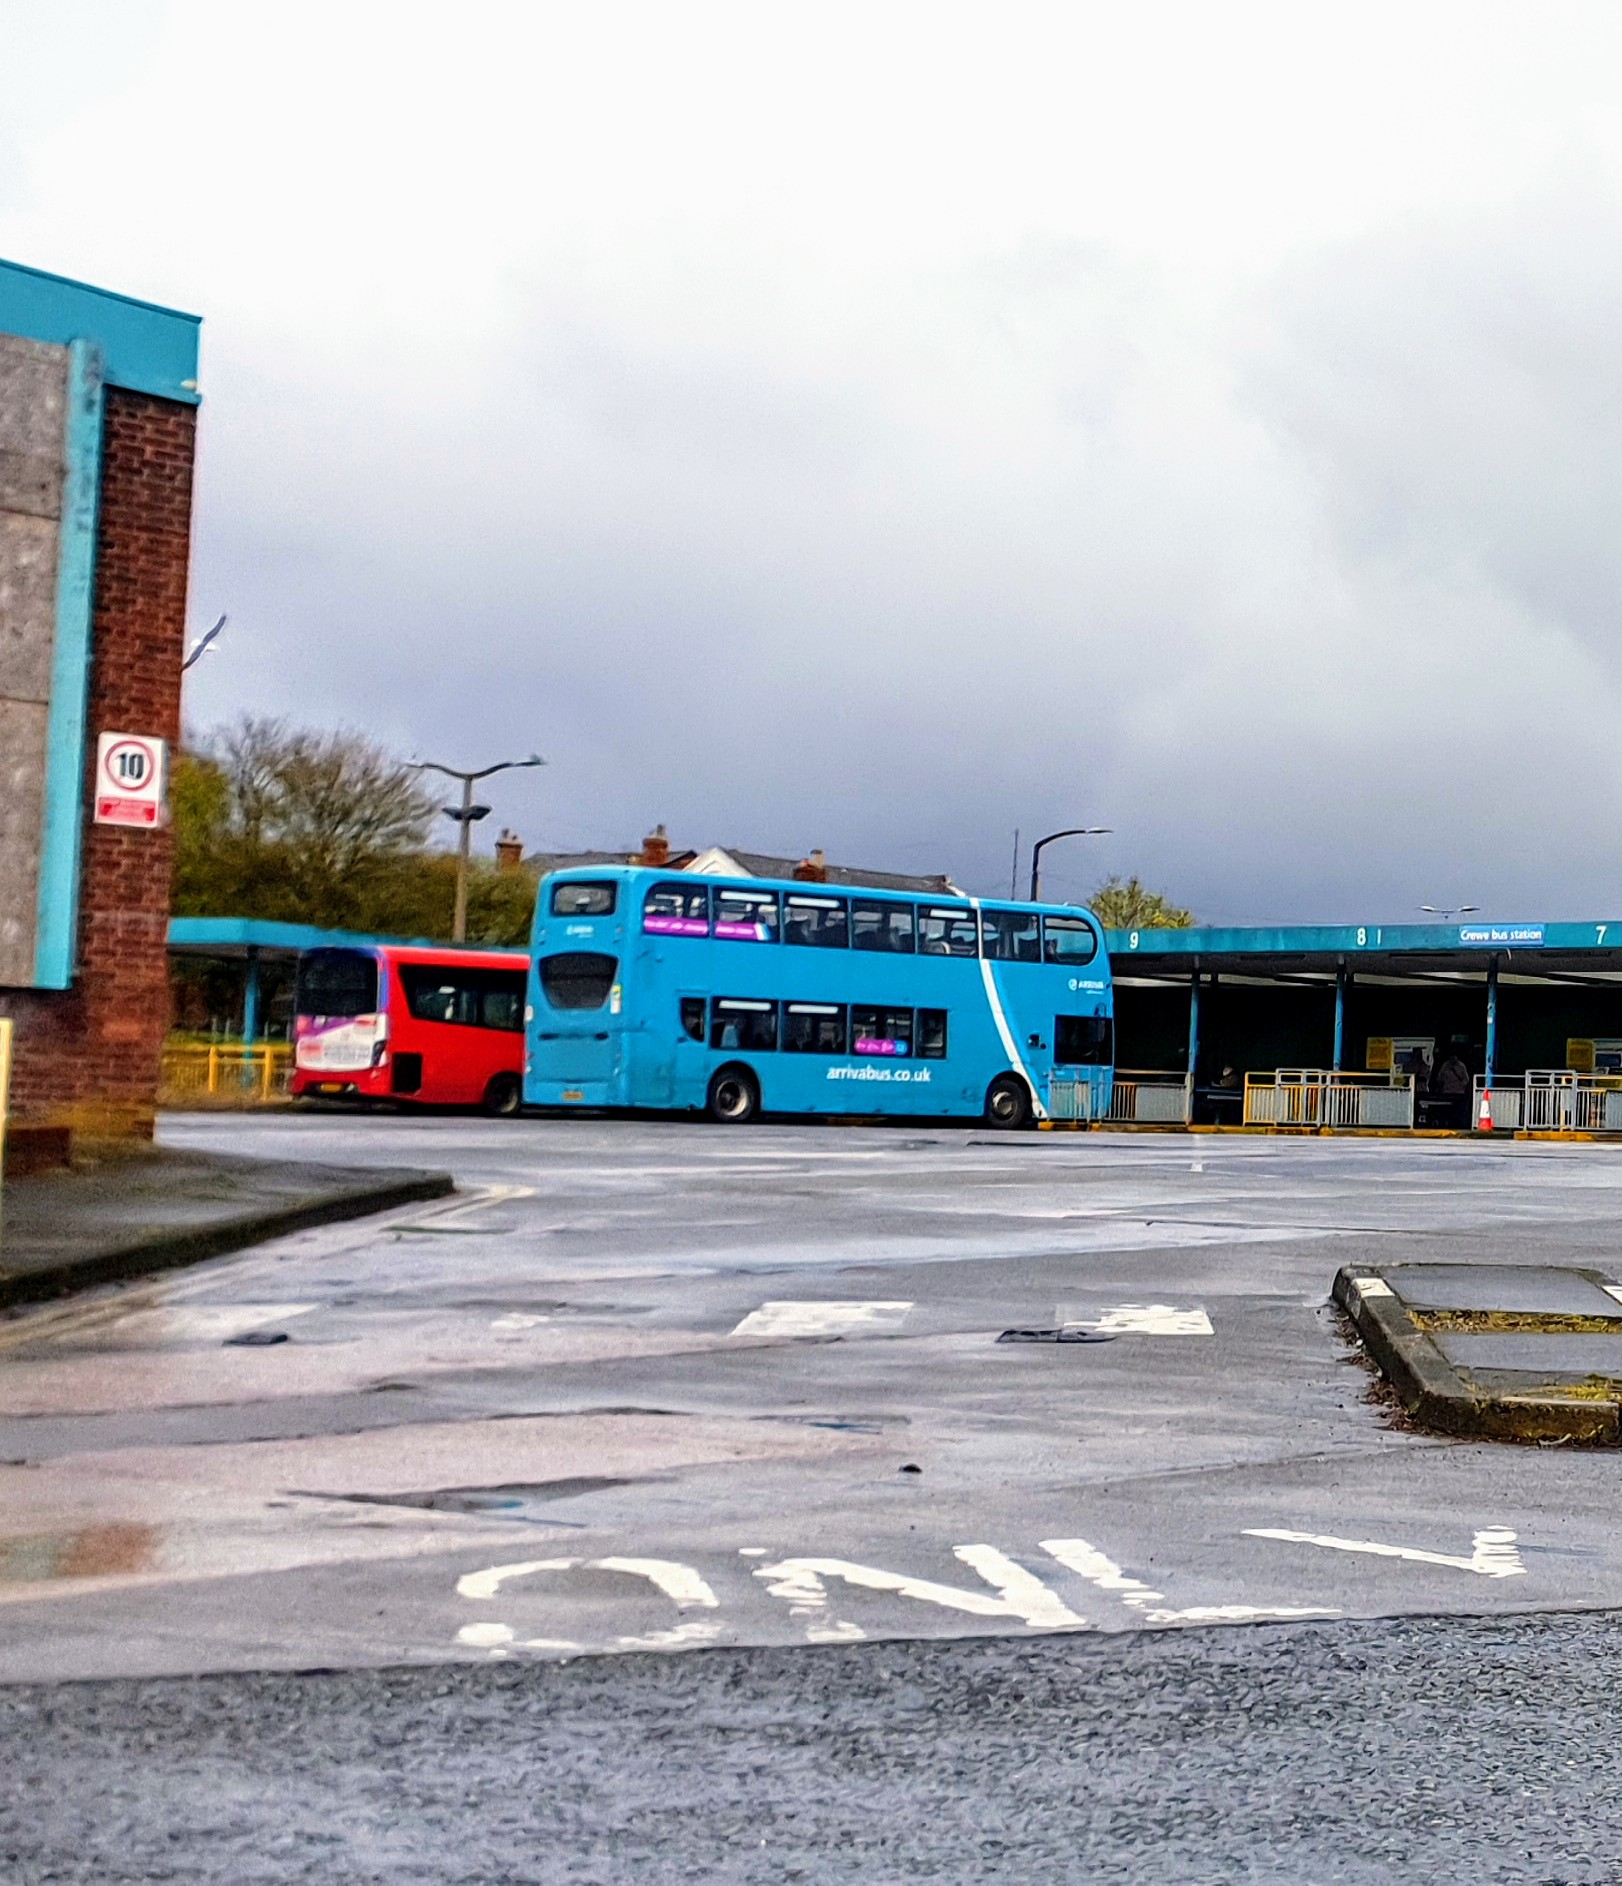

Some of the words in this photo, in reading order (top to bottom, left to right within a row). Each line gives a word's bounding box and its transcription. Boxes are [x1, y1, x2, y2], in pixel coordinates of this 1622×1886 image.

[117, 752, 144, 780] 10
[1130, 931, 1139, 949] 9
[1357, 927, 1366, 946] 8
[1460, 929, 1489, 941] Crewe
[1491, 928, 1508, 940] bus
[1510, 928, 1542, 940] station
[1595, 925, 1607, 945] 7
[826, 1063, 931, 1082] arrivabus.co.uk
